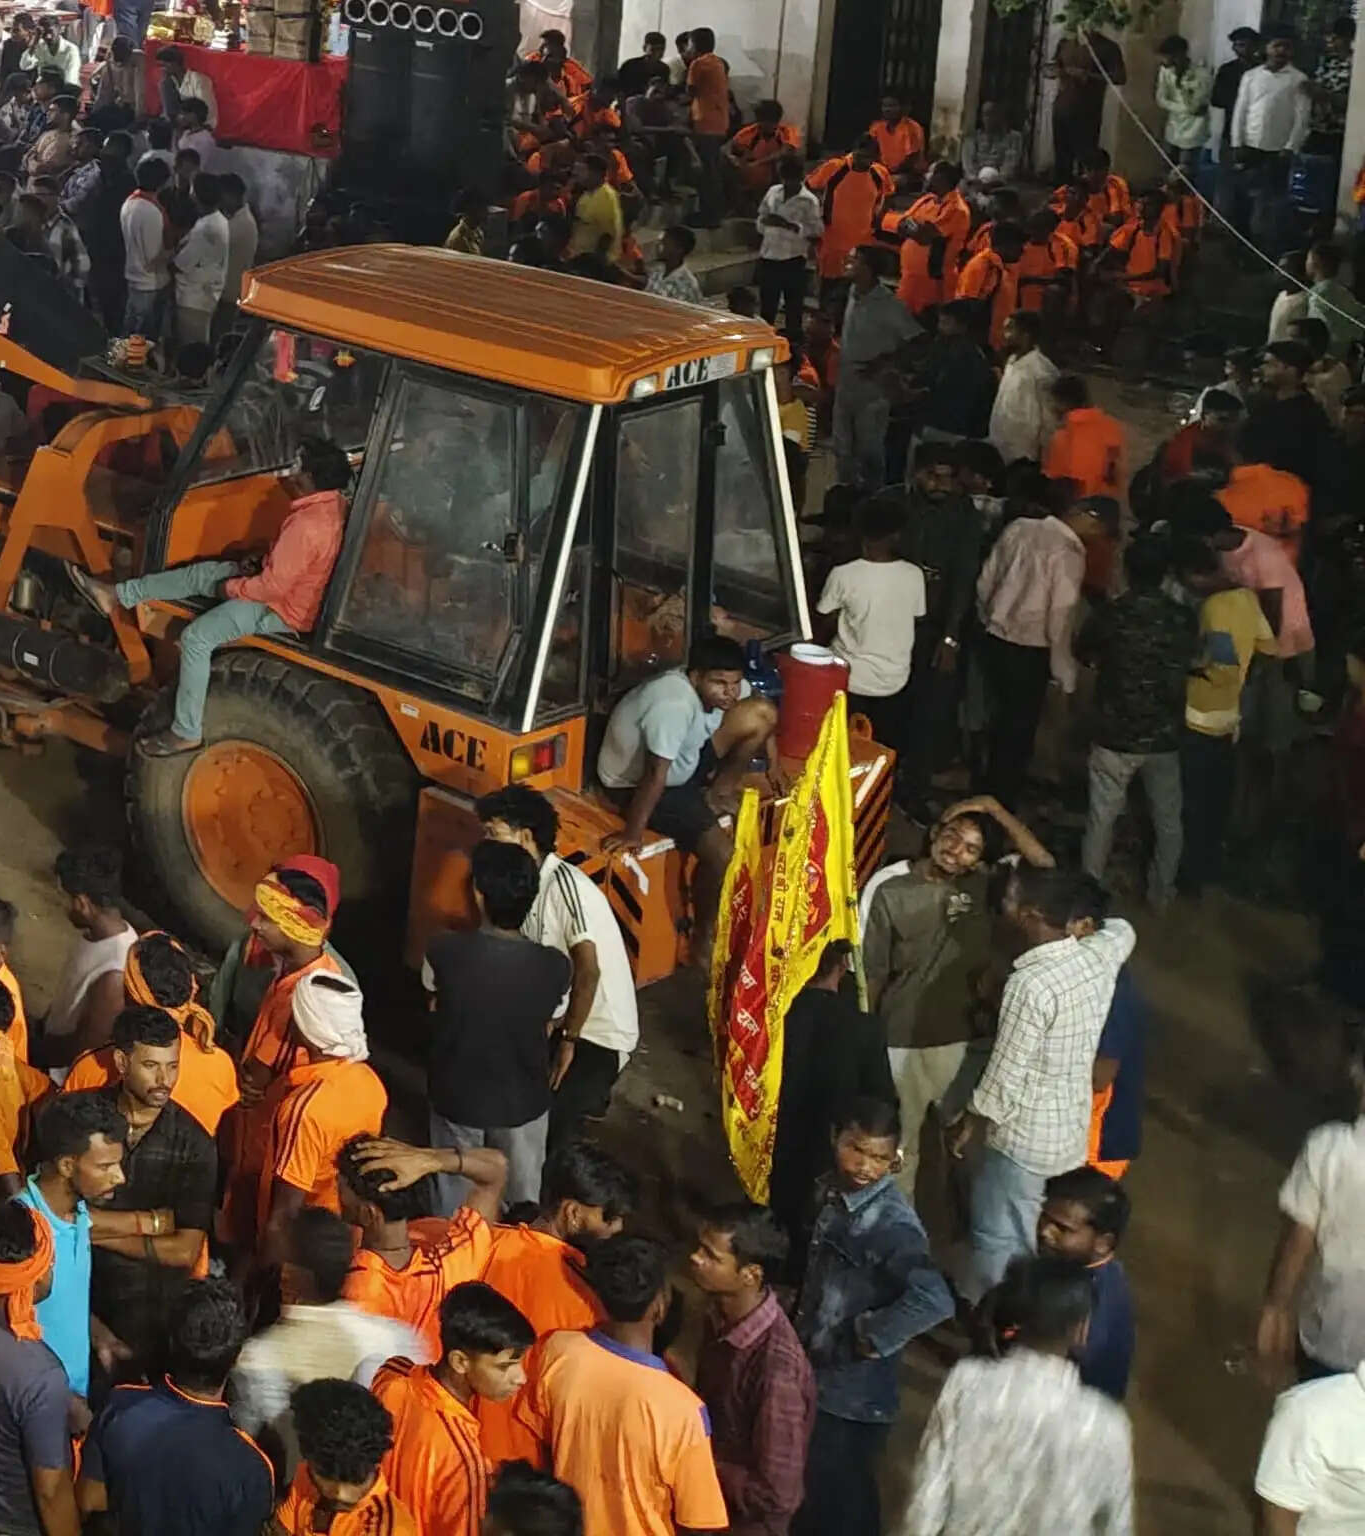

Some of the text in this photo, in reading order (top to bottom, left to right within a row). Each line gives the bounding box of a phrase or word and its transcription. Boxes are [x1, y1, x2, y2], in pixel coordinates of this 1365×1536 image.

[666, 356, 711, 389] ACE
[420, 719, 488, 772] ACE
[735, 1006, 761, 1037] राम
